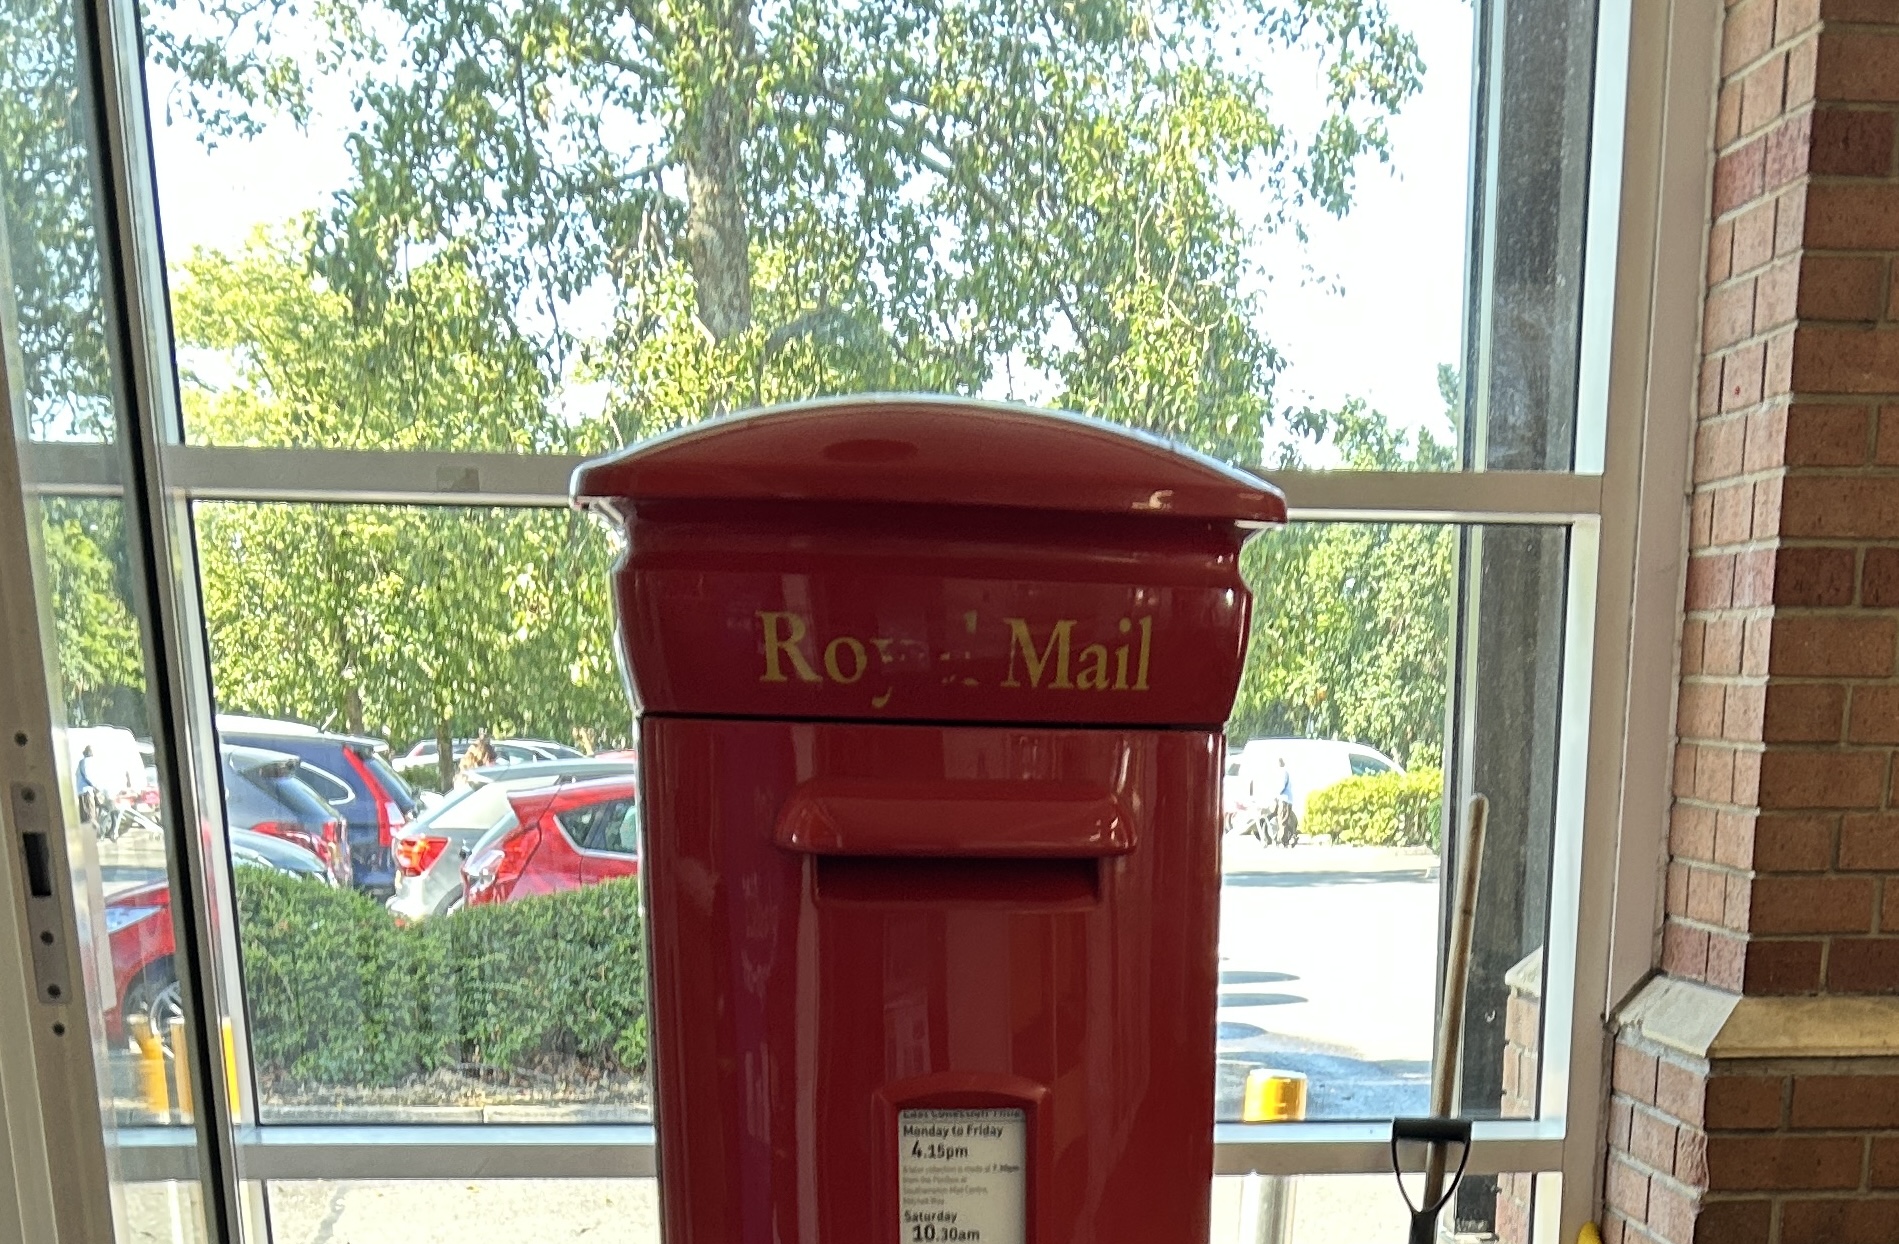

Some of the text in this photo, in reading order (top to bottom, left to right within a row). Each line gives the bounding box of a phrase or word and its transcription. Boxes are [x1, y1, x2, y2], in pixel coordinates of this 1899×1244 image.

[1001, 615, 1152, 691] Mail
[903, 1124, 1004, 1140] Monday to Friday
[911, 1140, 969, 1160] 4.15pm
[904, 1209, 957, 1223] Saturday
[912, 1224, 980, 1242] 10.30am
